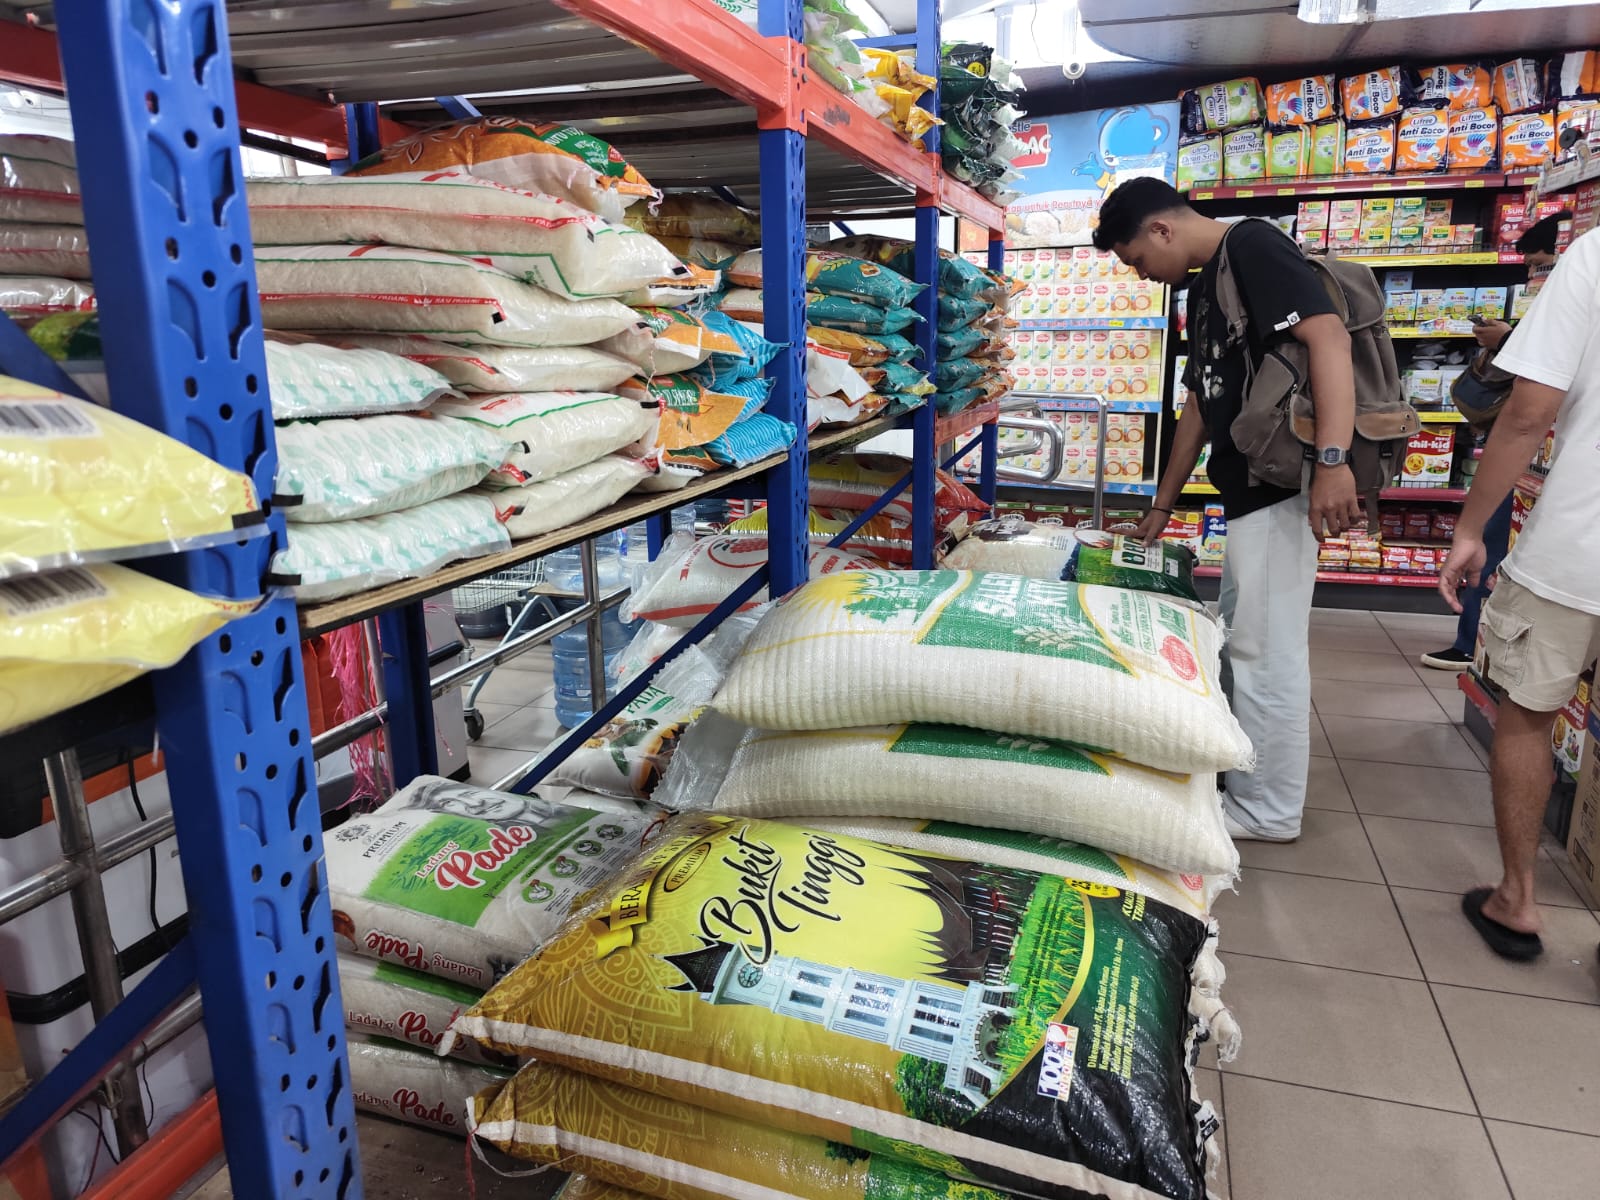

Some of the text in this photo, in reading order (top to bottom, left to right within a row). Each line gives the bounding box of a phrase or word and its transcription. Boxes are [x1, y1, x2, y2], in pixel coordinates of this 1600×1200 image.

[1315, 86, 1324, 108] Lifree
[1372, 91, 1380, 113] Bocor
[1306, 97, 1314, 121] Bocor
[1461, 113, 1483, 121] Lifree
[1400, 128, 1419, 136] Anti
[1413, 117, 1433, 125] Lifree
[1450, 122, 1495, 132] Anti Bocor
[1520, 122, 1541, 131] Lifree
[1235, 133, 1254, 141] Lifree
[1359, 138, 1378, 146] Lifree
[1408, 440, 1450, 449] chil-kid
[362, 820, 407, 859] PREMIUM
[416, 840, 459, 878] Ladang
[435, 826, 536, 890] Pade
[670, 847, 706, 885] PREMIUM
[777, 832, 866, 922] Tinggi
[699, 825, 799, 966] Bukit
[365, 931, 431, 970] Pade
[433, 953, 485, 982] Ladang
[349, 1011, 394, 1032] Ladang
[352, 1091, 393, 1113] adang
[393, 1087, 457, 1127] Pade
